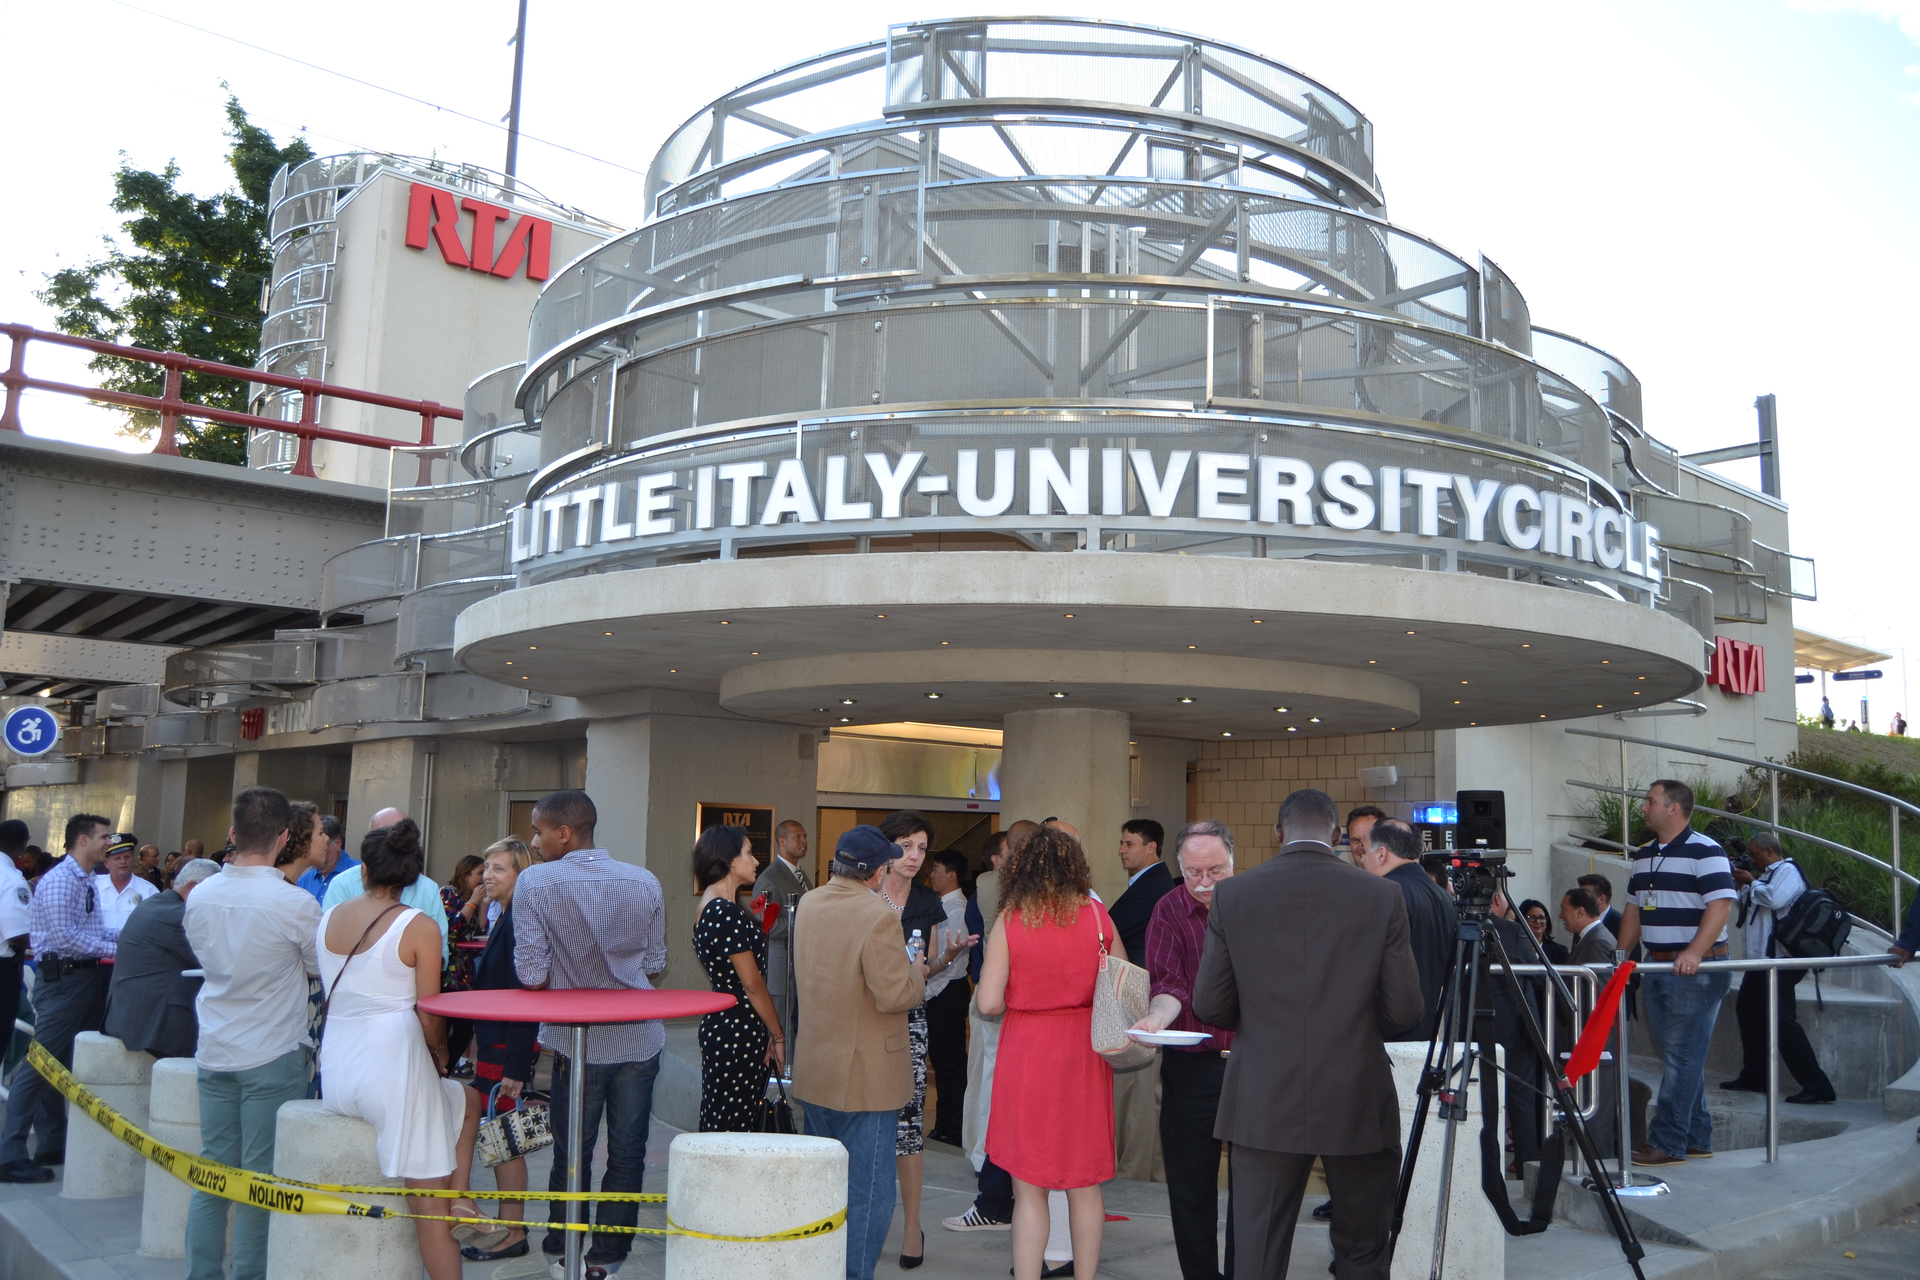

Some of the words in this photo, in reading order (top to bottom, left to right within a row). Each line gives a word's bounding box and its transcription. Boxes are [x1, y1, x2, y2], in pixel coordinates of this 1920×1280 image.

[405, 182, 553, 282] RTA
[511, 471, 679, 563] LITTLE
[1500, 484, 1661, 584] CIRCLE
[1707, 636, 1766, 695] RTA
[723, 812, 751, 827] RTA
[151, 1144, 175, 1172] CAUTION
[187, 1163, 227, 1193] CAUTION
[249, 1182, 304, 1213] CAUTION
